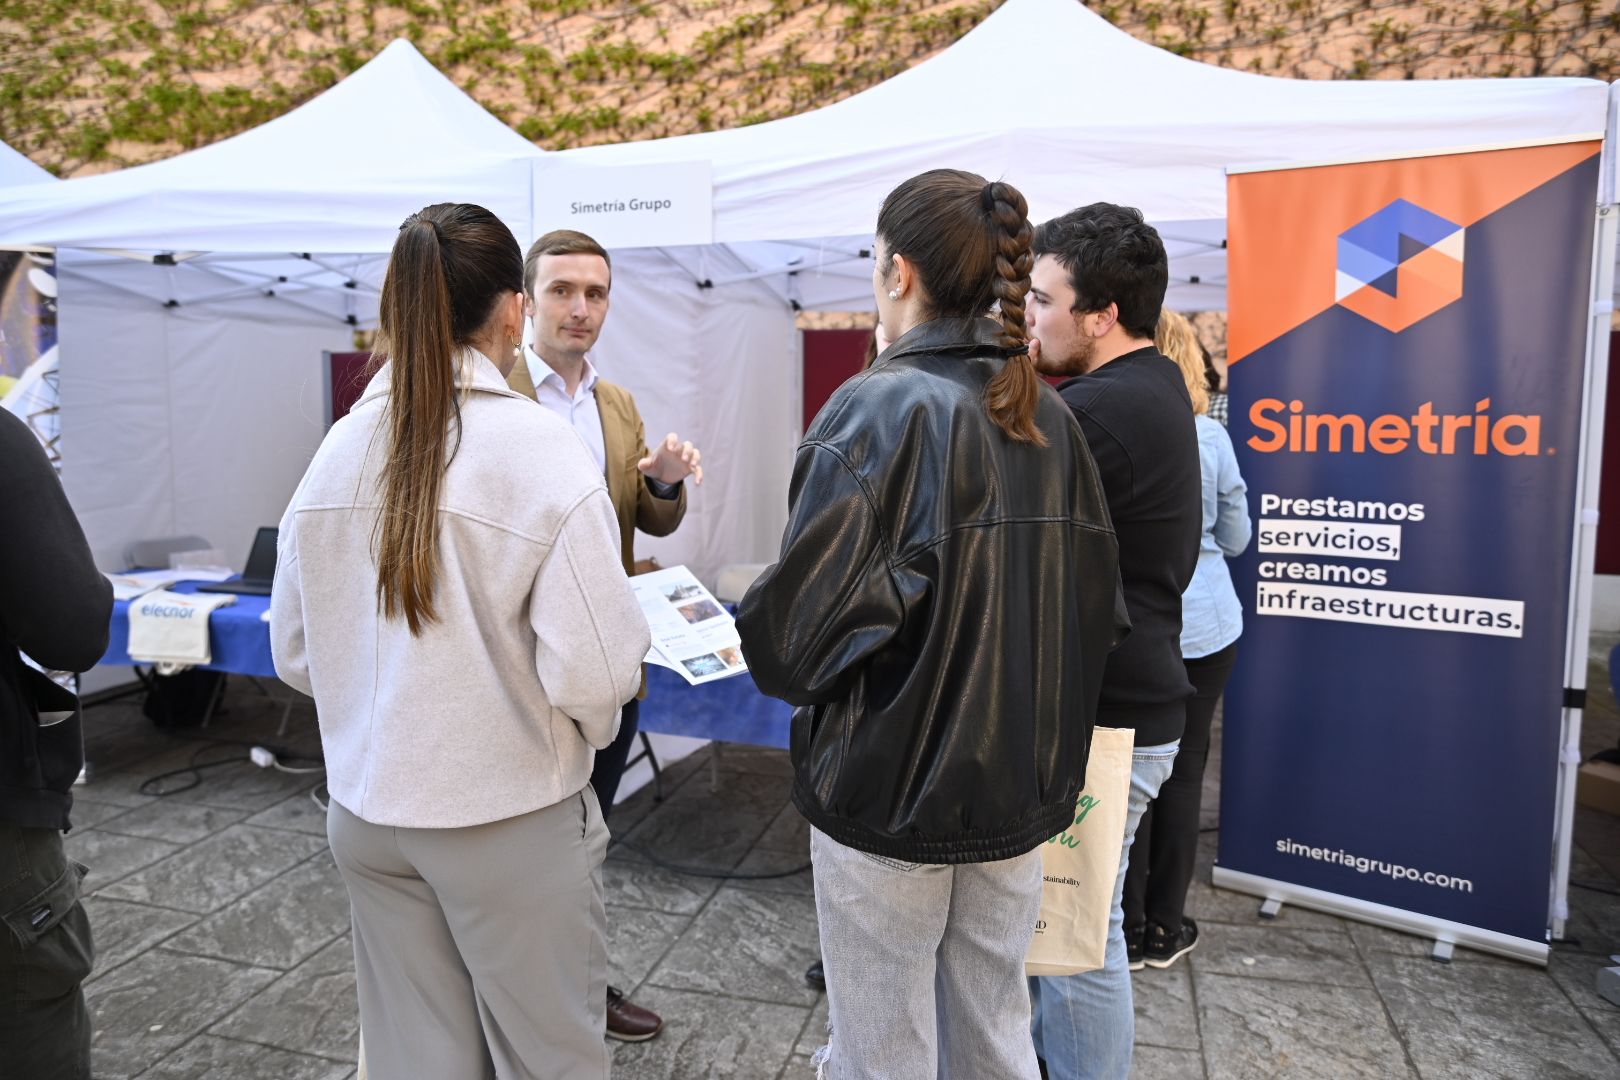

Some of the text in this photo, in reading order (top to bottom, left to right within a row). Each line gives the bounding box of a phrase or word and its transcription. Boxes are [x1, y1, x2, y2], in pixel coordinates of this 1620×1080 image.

[571, 198, 671, 214] Simetría Grupo
[1260, 494, 1425, 522] Prestamos
[1260, 527, 1399, 557] servicios,
[1258, 560, 1388, 586] creamos
[1258, 587, 1521, 630] infraestructuras.
[1276, 838, 1473, 893] simetriagrupo.com
[1043, 875, 1080, 888] stainability
